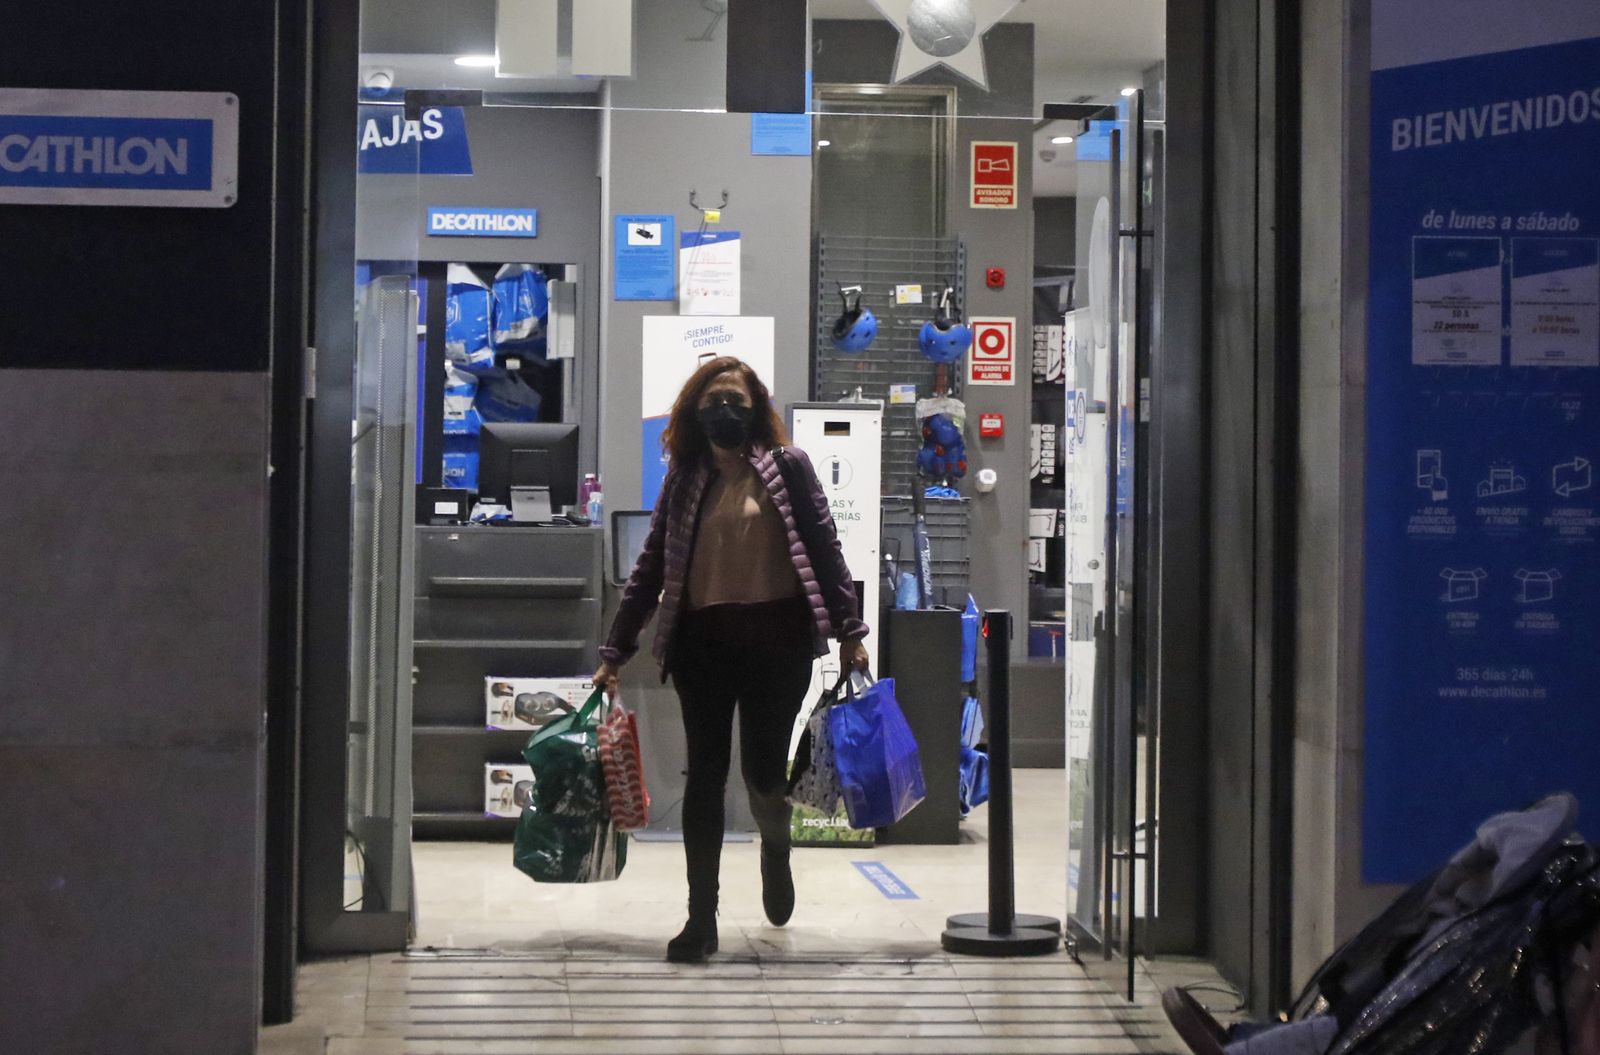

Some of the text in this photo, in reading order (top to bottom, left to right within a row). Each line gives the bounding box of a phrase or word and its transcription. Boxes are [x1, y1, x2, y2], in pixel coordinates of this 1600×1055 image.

[1391, 87, 1600, 151] BIENVENIDOS
[360, 108, 444, 151] AJAS
[0, 134, 188, 175] CATHLON
[431, 213, 532, 231] DECATHLON
[1422, 209, 1580, 231] de lunes a sábado
[692, 334, 733, 348] CONTIGO!
[848, 500, 854, 508] Y
[1456, 668, 1479, 681] 365
[1438, 685, 1547, 698] www.decathlon.es
